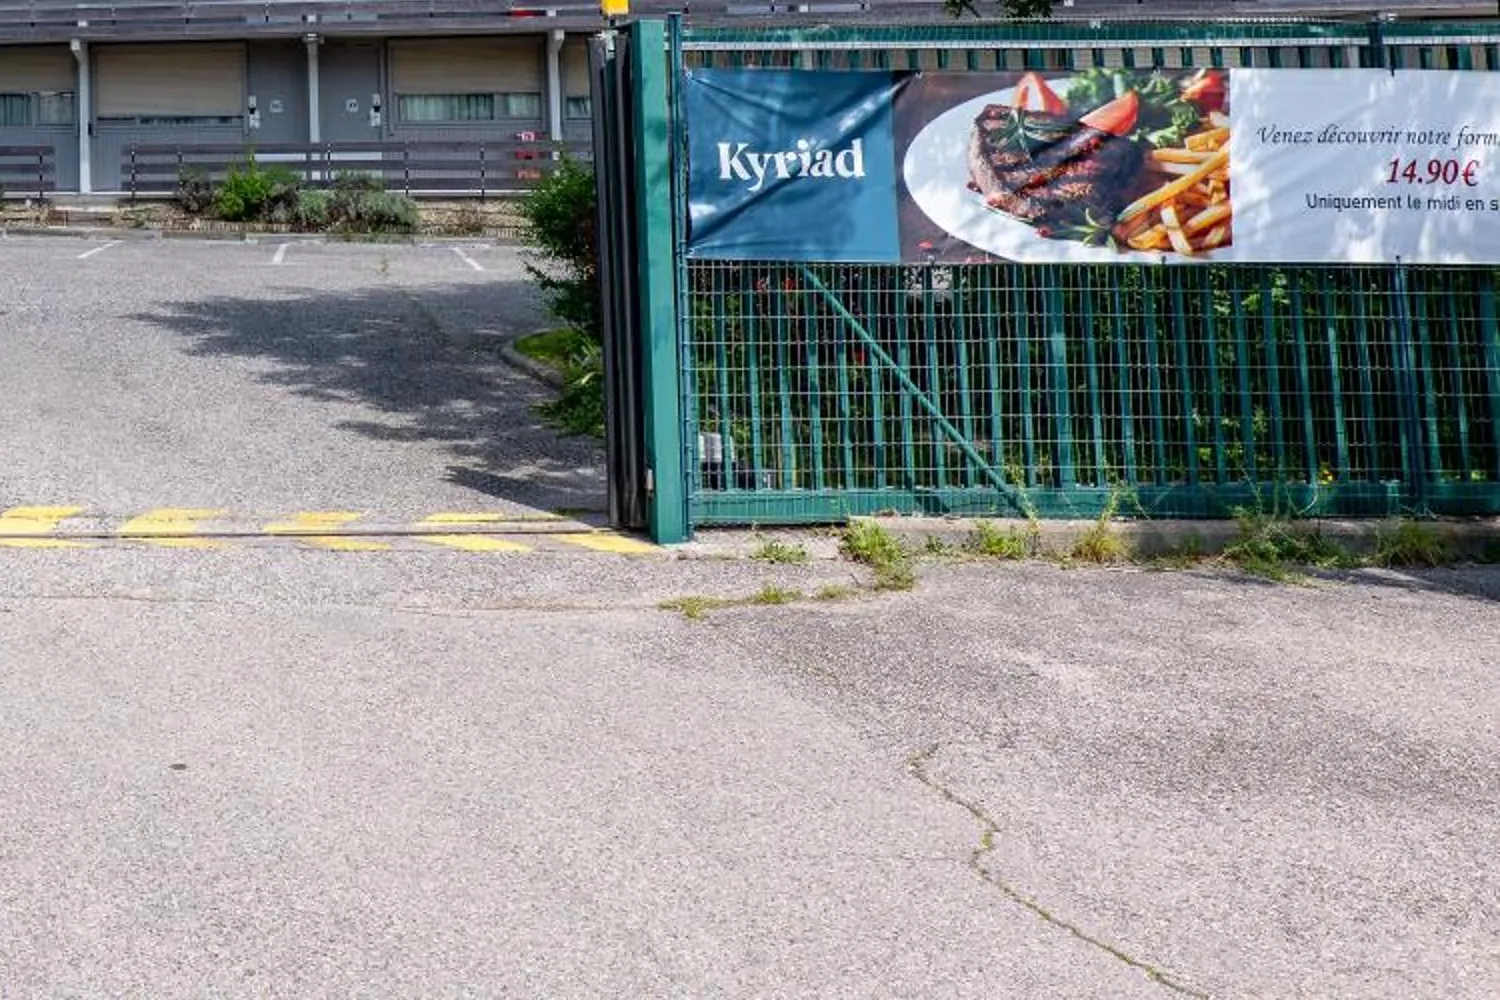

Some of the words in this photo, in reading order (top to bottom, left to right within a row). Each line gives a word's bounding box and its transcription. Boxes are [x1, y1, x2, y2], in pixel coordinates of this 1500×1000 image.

[1257, 123, 1313, 144] Venez
[1317, 123, 1402, 144] découvrir
[1407, 130, 1451, 145] notre
[717, 138, 866, 193] Kyriad
[1306, 193, 1401, 212] Uniquement
[1408, 195, 1422, 210] le
[1428, 196, 1461, 211] midi
[1465, 199, 1485, 211] en
